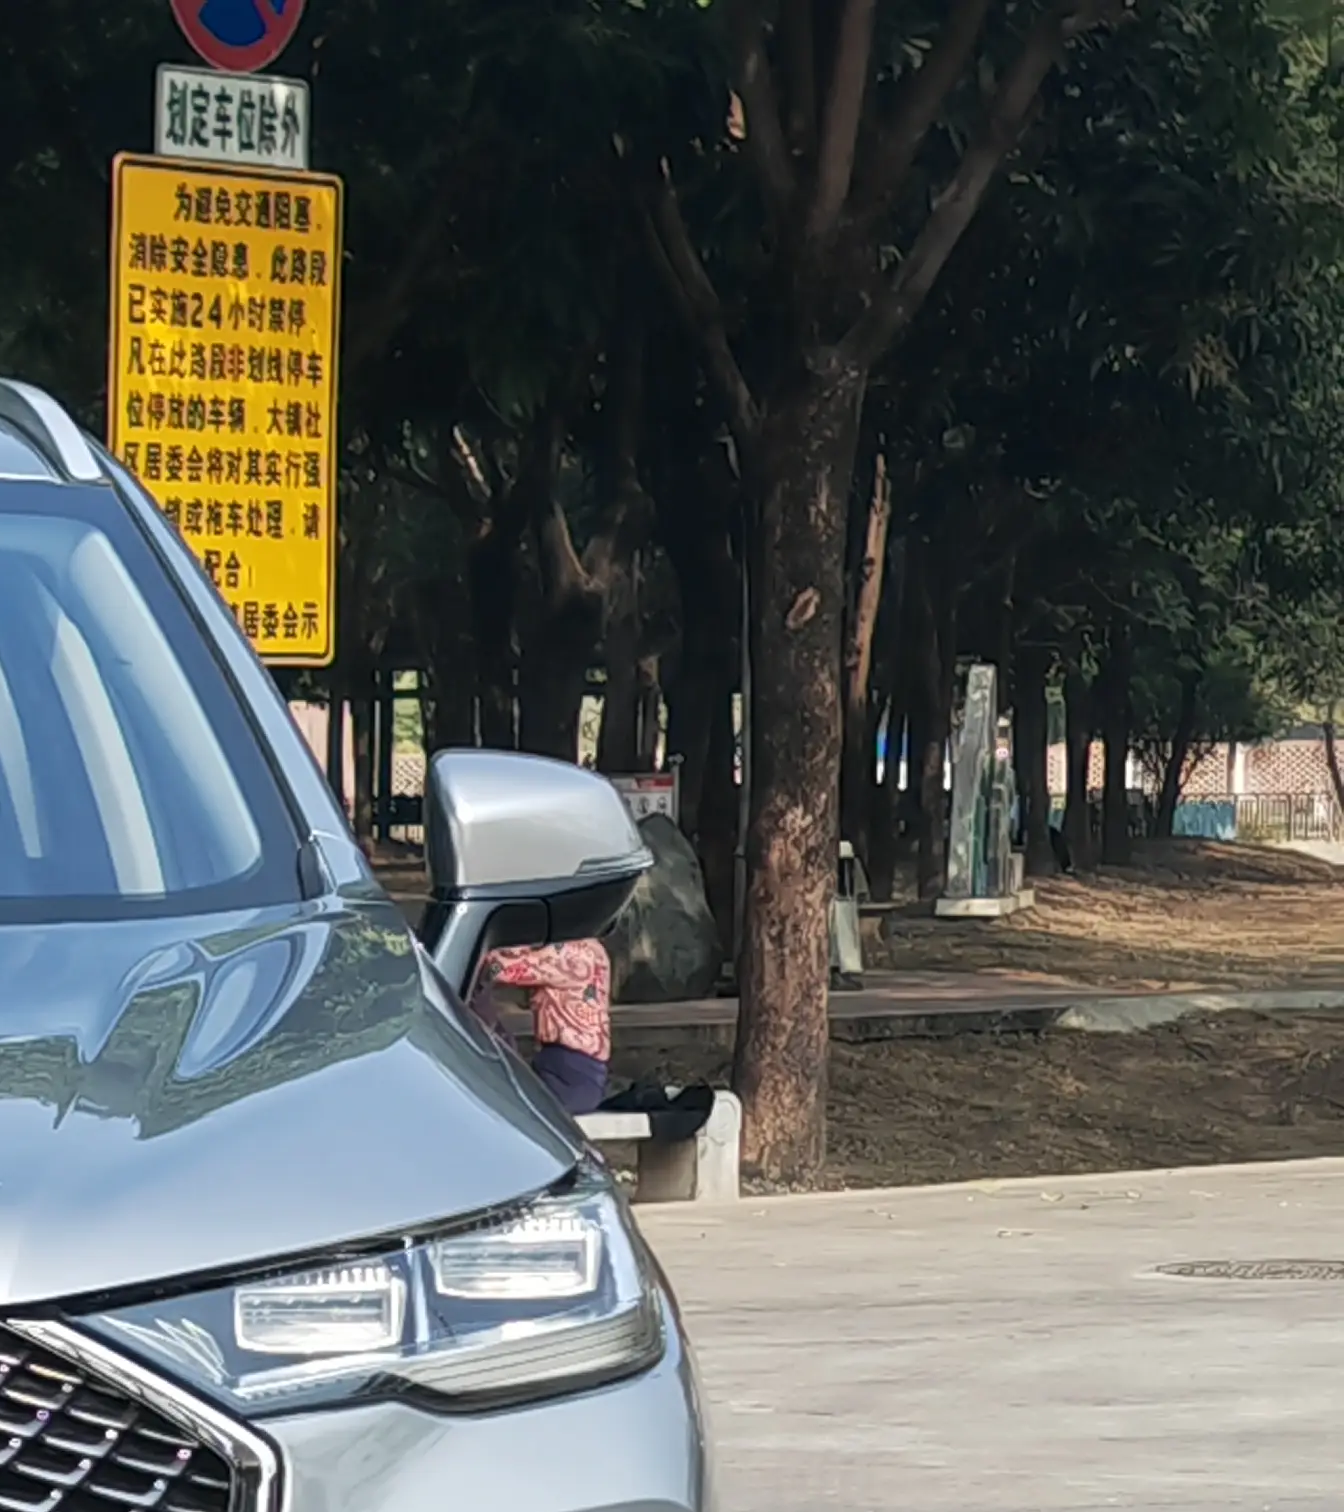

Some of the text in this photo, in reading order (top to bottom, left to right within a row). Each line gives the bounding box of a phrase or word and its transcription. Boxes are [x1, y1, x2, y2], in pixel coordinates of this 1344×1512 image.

[124, 442, 322, 489] 区居委会将对其实行强
